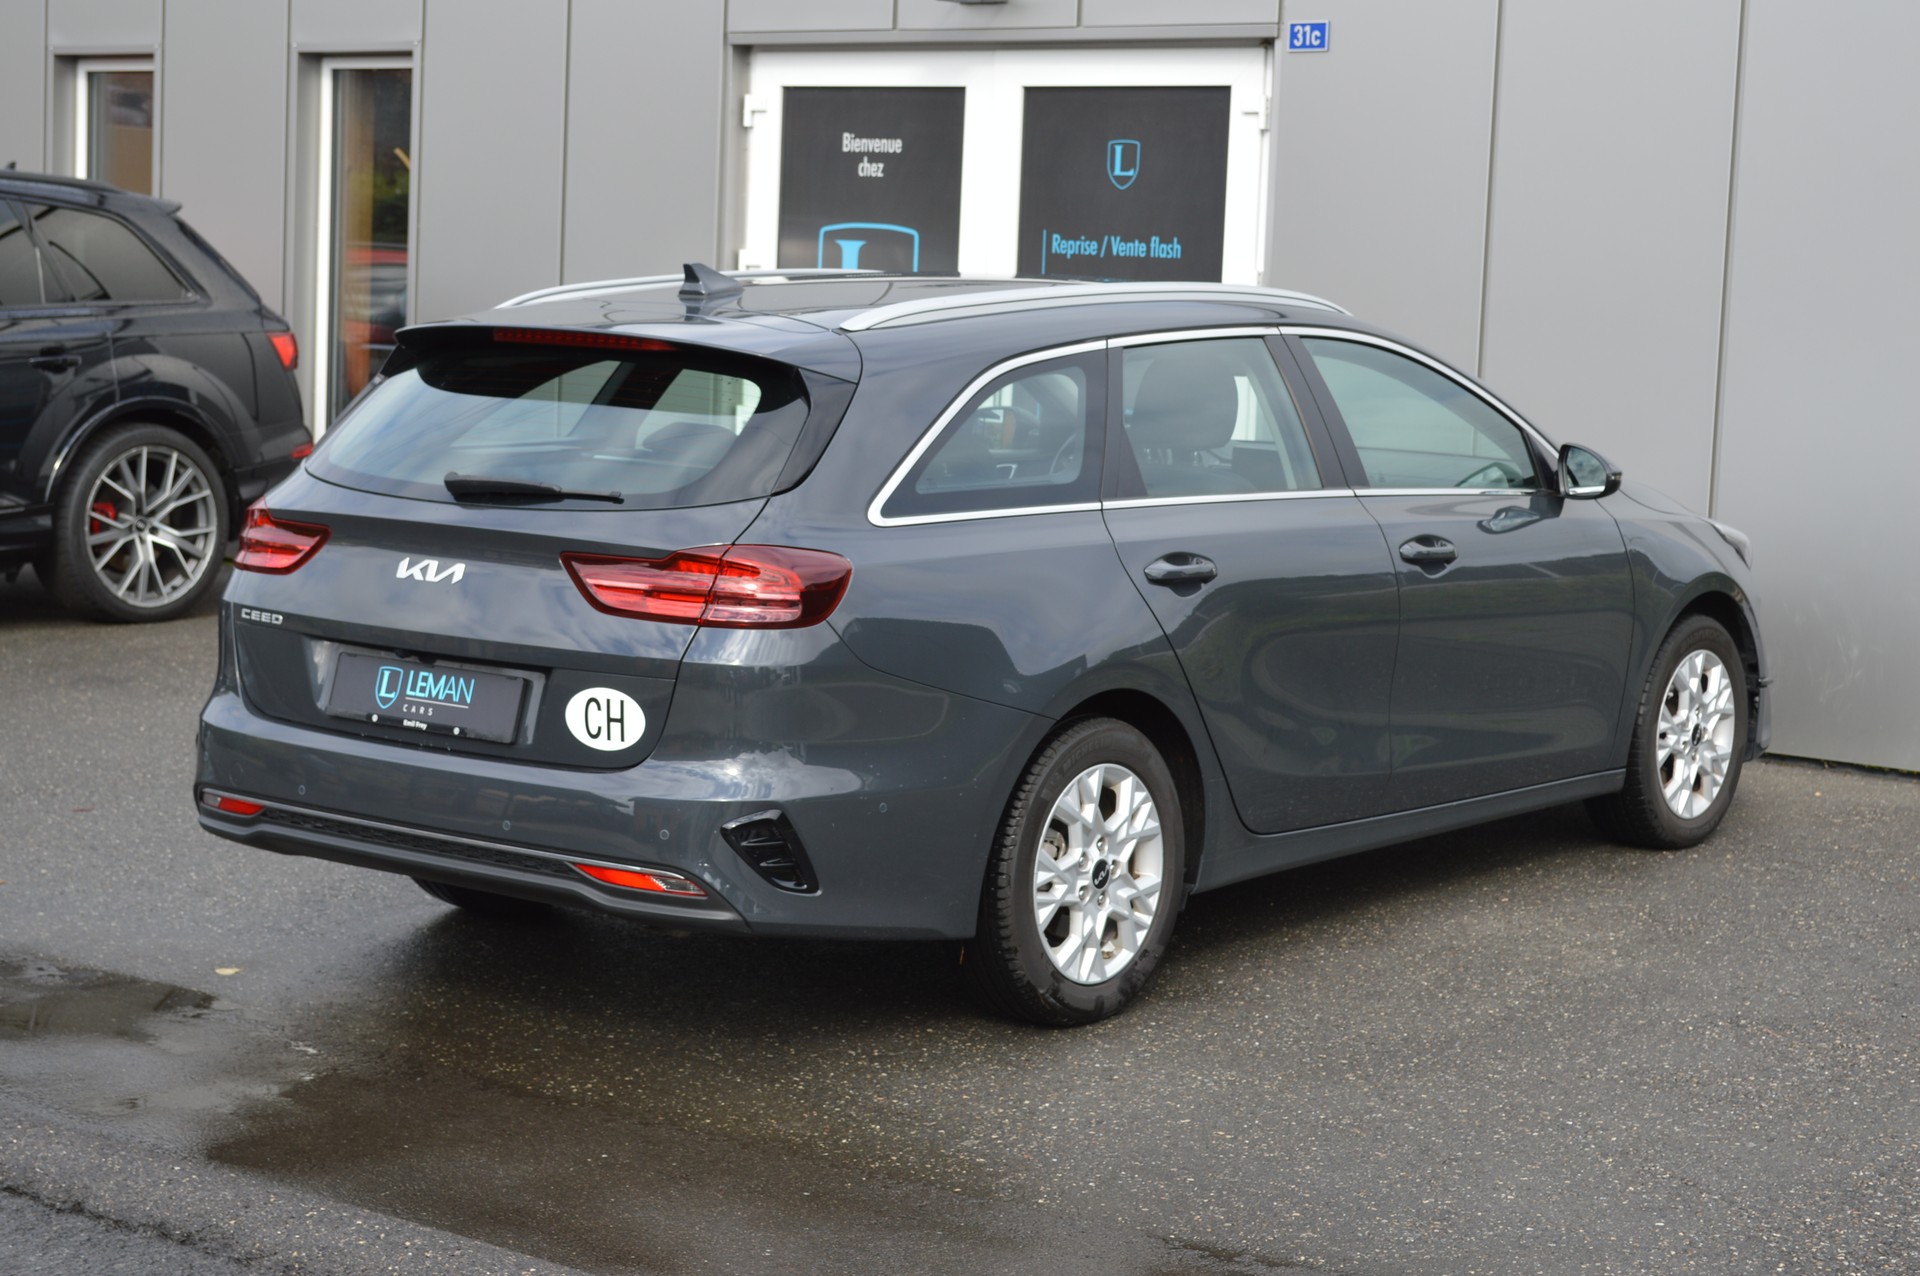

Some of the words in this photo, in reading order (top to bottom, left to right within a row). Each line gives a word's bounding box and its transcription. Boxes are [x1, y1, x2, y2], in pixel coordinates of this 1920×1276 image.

[1293, 24, 1321, 47] 31c
[842, 132, 903, 154] Bienvenue
[857, 155, 885, 177] chez
[1051, 232, 1098, 260] Reprise
[1111, 235, 1147, 257] Vente
[1150, 235, 1182, 259] flash
[396, 556, 466, 584] KIA
[241, 607, 284, 625] CEED
[405, 669, 475, 705] LEMAN
[402, 703, 434, 717] CARS
[584, 697, 625, 742] CH
